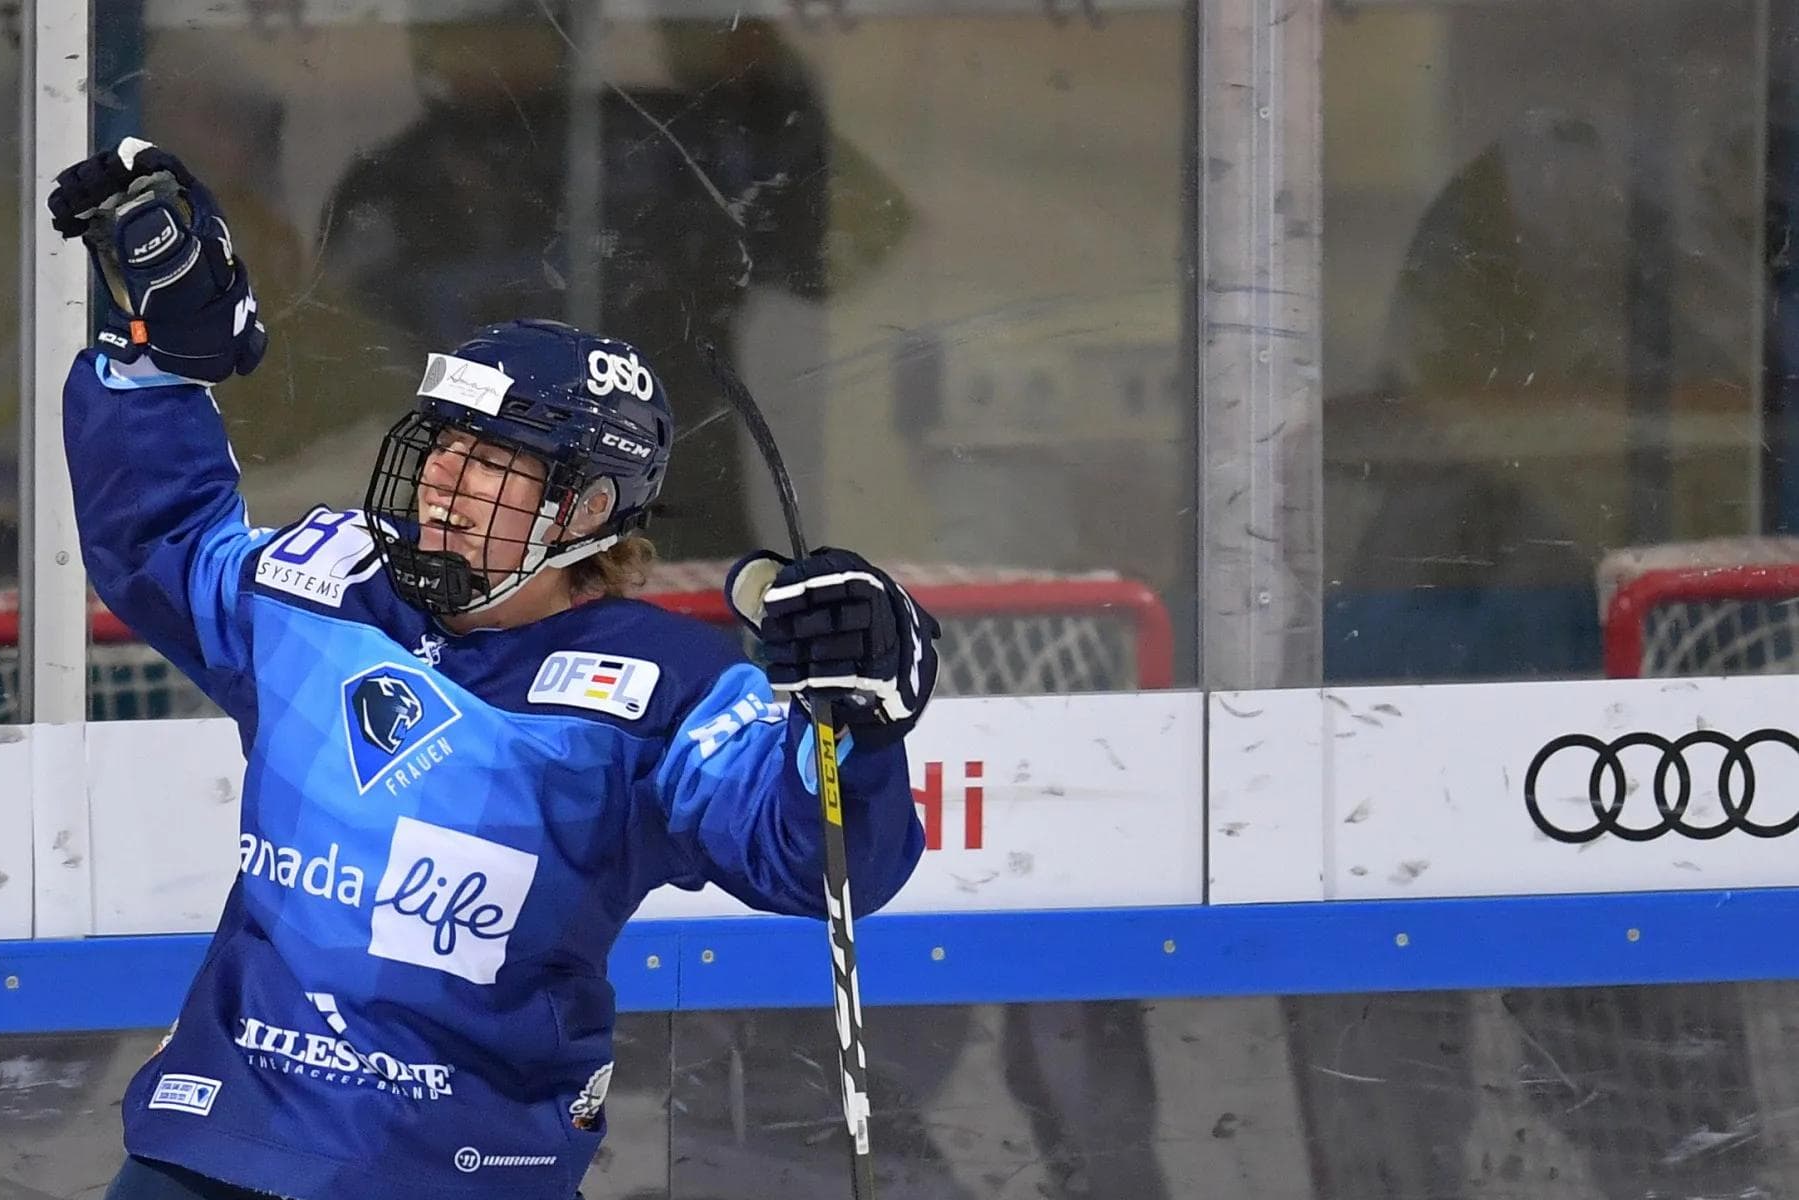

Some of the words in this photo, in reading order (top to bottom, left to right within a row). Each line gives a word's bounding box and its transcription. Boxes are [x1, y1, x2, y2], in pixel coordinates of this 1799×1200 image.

[587, 349, 654, 402] gsb
[602, 432, 651, 459] CCM
[258, 562, 341, 600] SYSTEMS
[385, 736, 454, 797] FRAUEN
[824, 737, 842, 812] CCM
[240, 833, 364, 908] anada
[376, 857, 513, 956] life
[235, 1018, 453, 1095] MILESONE
[282, 1060, 366, 1085] JACKET
[483, 1154, 557, 1167] WARRIOR
